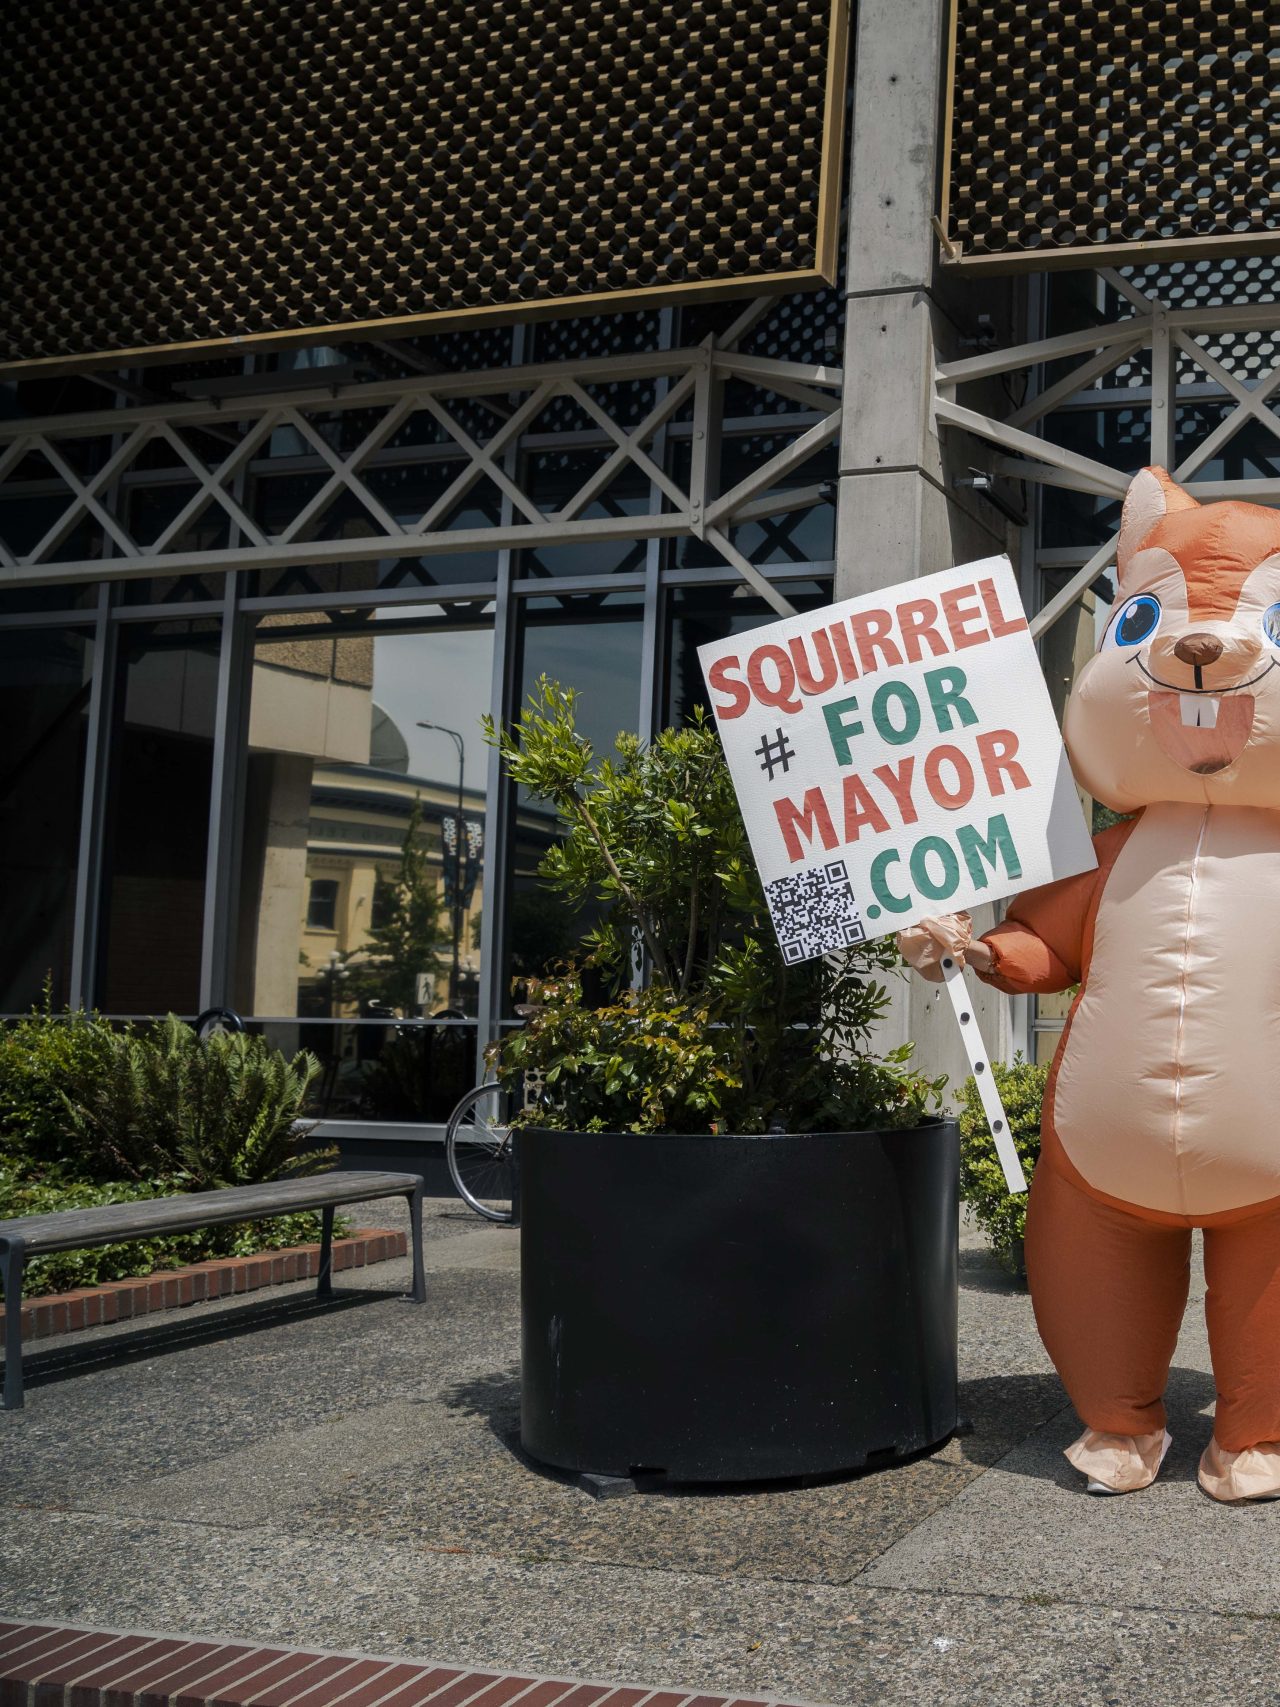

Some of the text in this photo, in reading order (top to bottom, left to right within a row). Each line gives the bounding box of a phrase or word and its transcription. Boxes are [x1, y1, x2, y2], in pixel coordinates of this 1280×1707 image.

[708, 577, 1028, 720] SQUIRREL
[754, 666, 979, 781] # FOR
[772, 729, 1031, 863] MAYOR
[866, 813, 1022, 920] .COM
